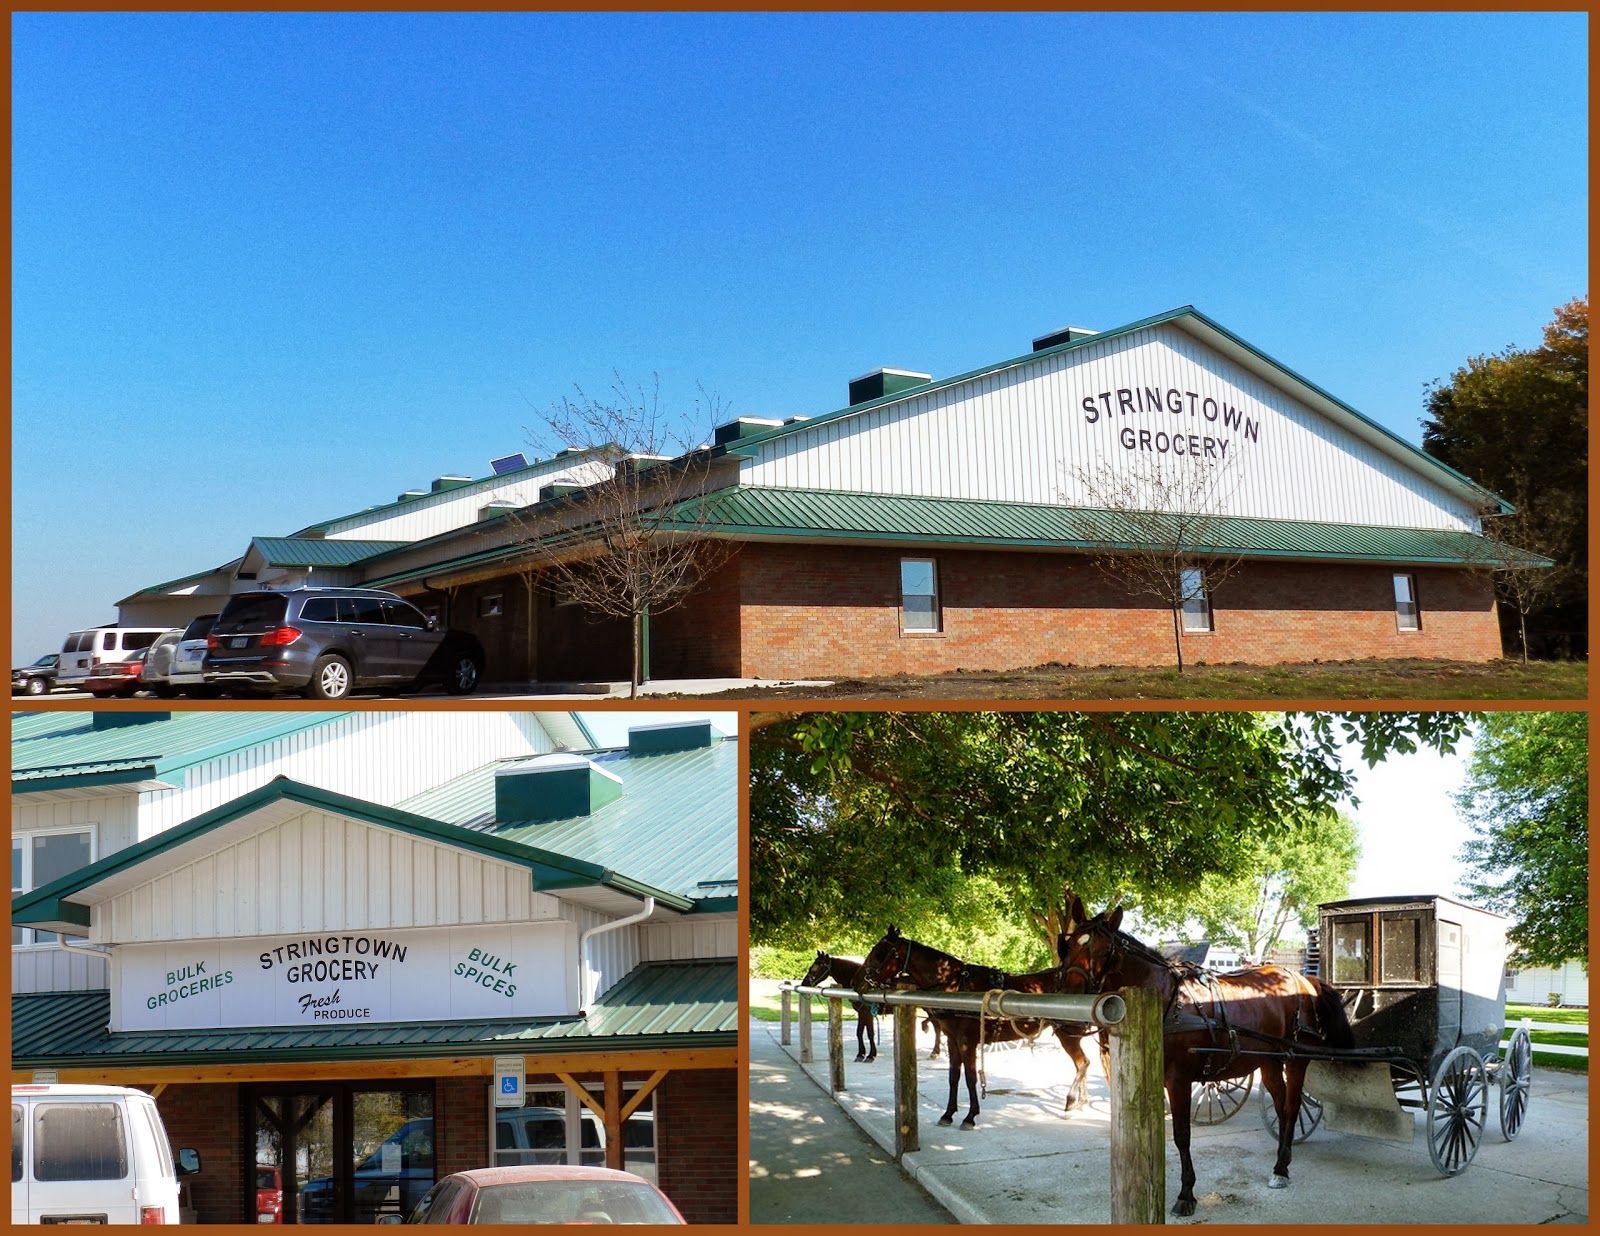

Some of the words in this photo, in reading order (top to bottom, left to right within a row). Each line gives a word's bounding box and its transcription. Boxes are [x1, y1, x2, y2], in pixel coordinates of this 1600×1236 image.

[1082, 387, 1259, 443] STRINGTOWN
[1120, 427, 1229, 459] GROCERY
[259, 937, 408, 970] STRINGTOWN
[468, 948, 517, 977] BULK
[166, 960, 207, 985] BULK
[286, 959, 380, 983] GROCERY
[454, 962, 517, 998] SPICES
[147, 970, 233, 1009] GROCERIES
[298, 988, 341, 1014] Fresh
[314, 1008, 371, 1020] PRODUCE
